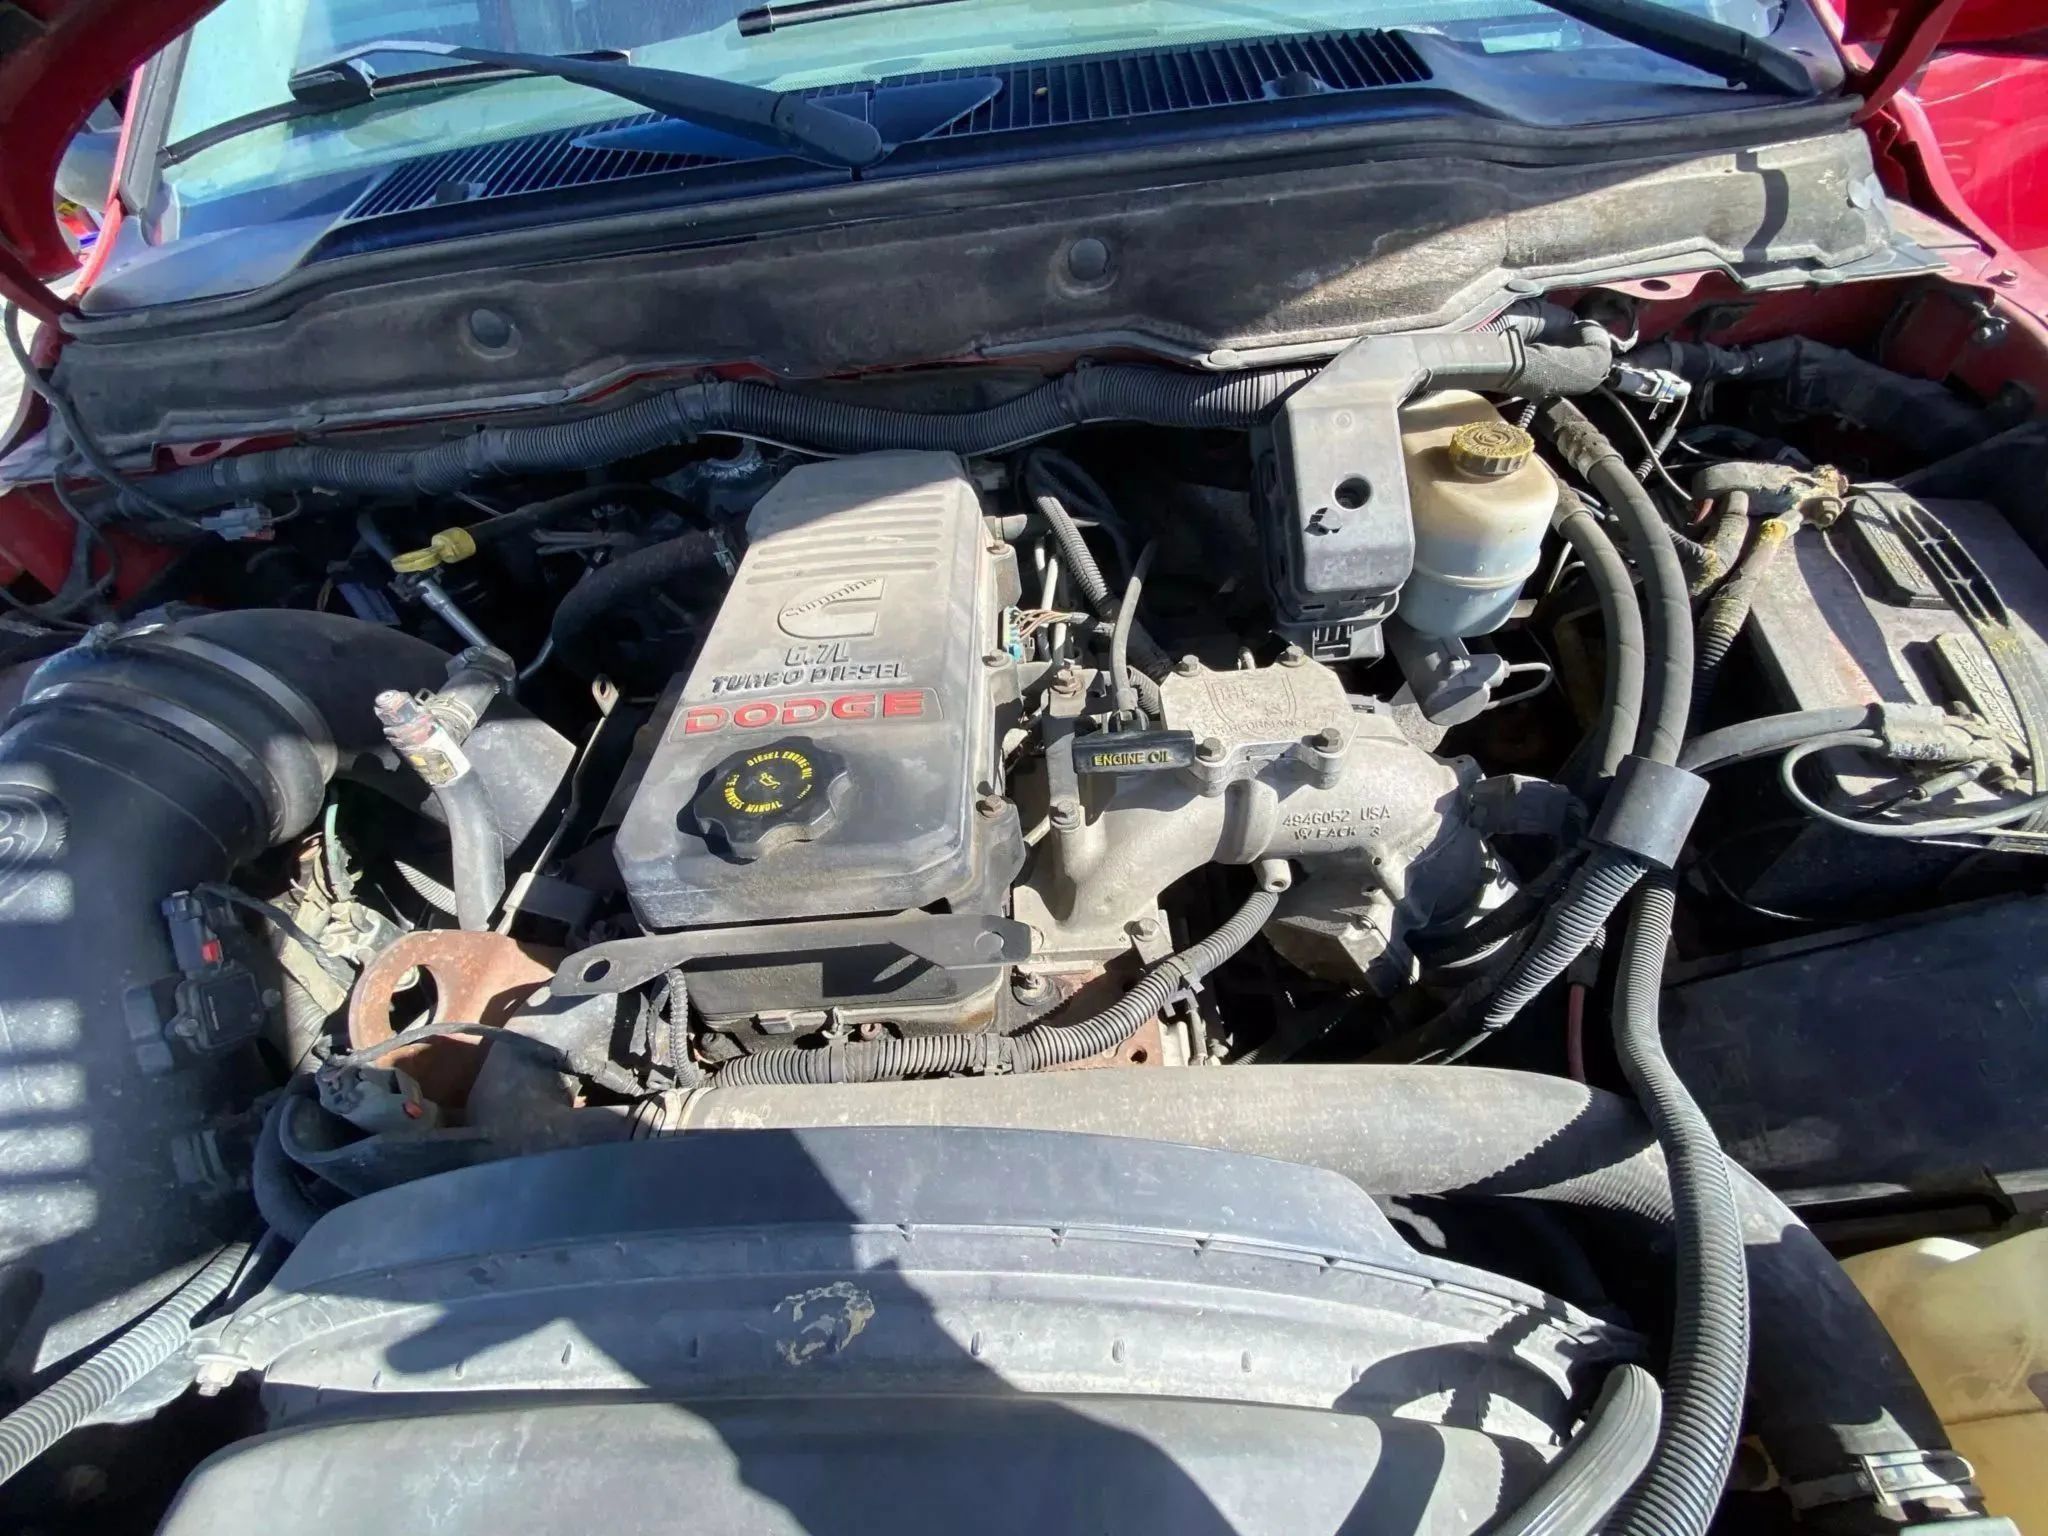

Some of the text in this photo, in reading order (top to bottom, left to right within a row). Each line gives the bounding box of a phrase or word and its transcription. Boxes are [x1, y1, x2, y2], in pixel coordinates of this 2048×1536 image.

[785, 577, 878, 617] Cummins
[784, 642, 850, 667] 6.7L
[711, 661, 911, 695] TURBO DIESEL
[684, 692, 923, 734] DODGE
[747, 751, 780, 767] DIESEL
[782, 751, 810, 769] ENGINE
[1092, 750, 1171, 766] ENGINE OIL
[744, 800, 783, 813] MANUAL
[1282, 804, 1391, 827] 4946052 USA
